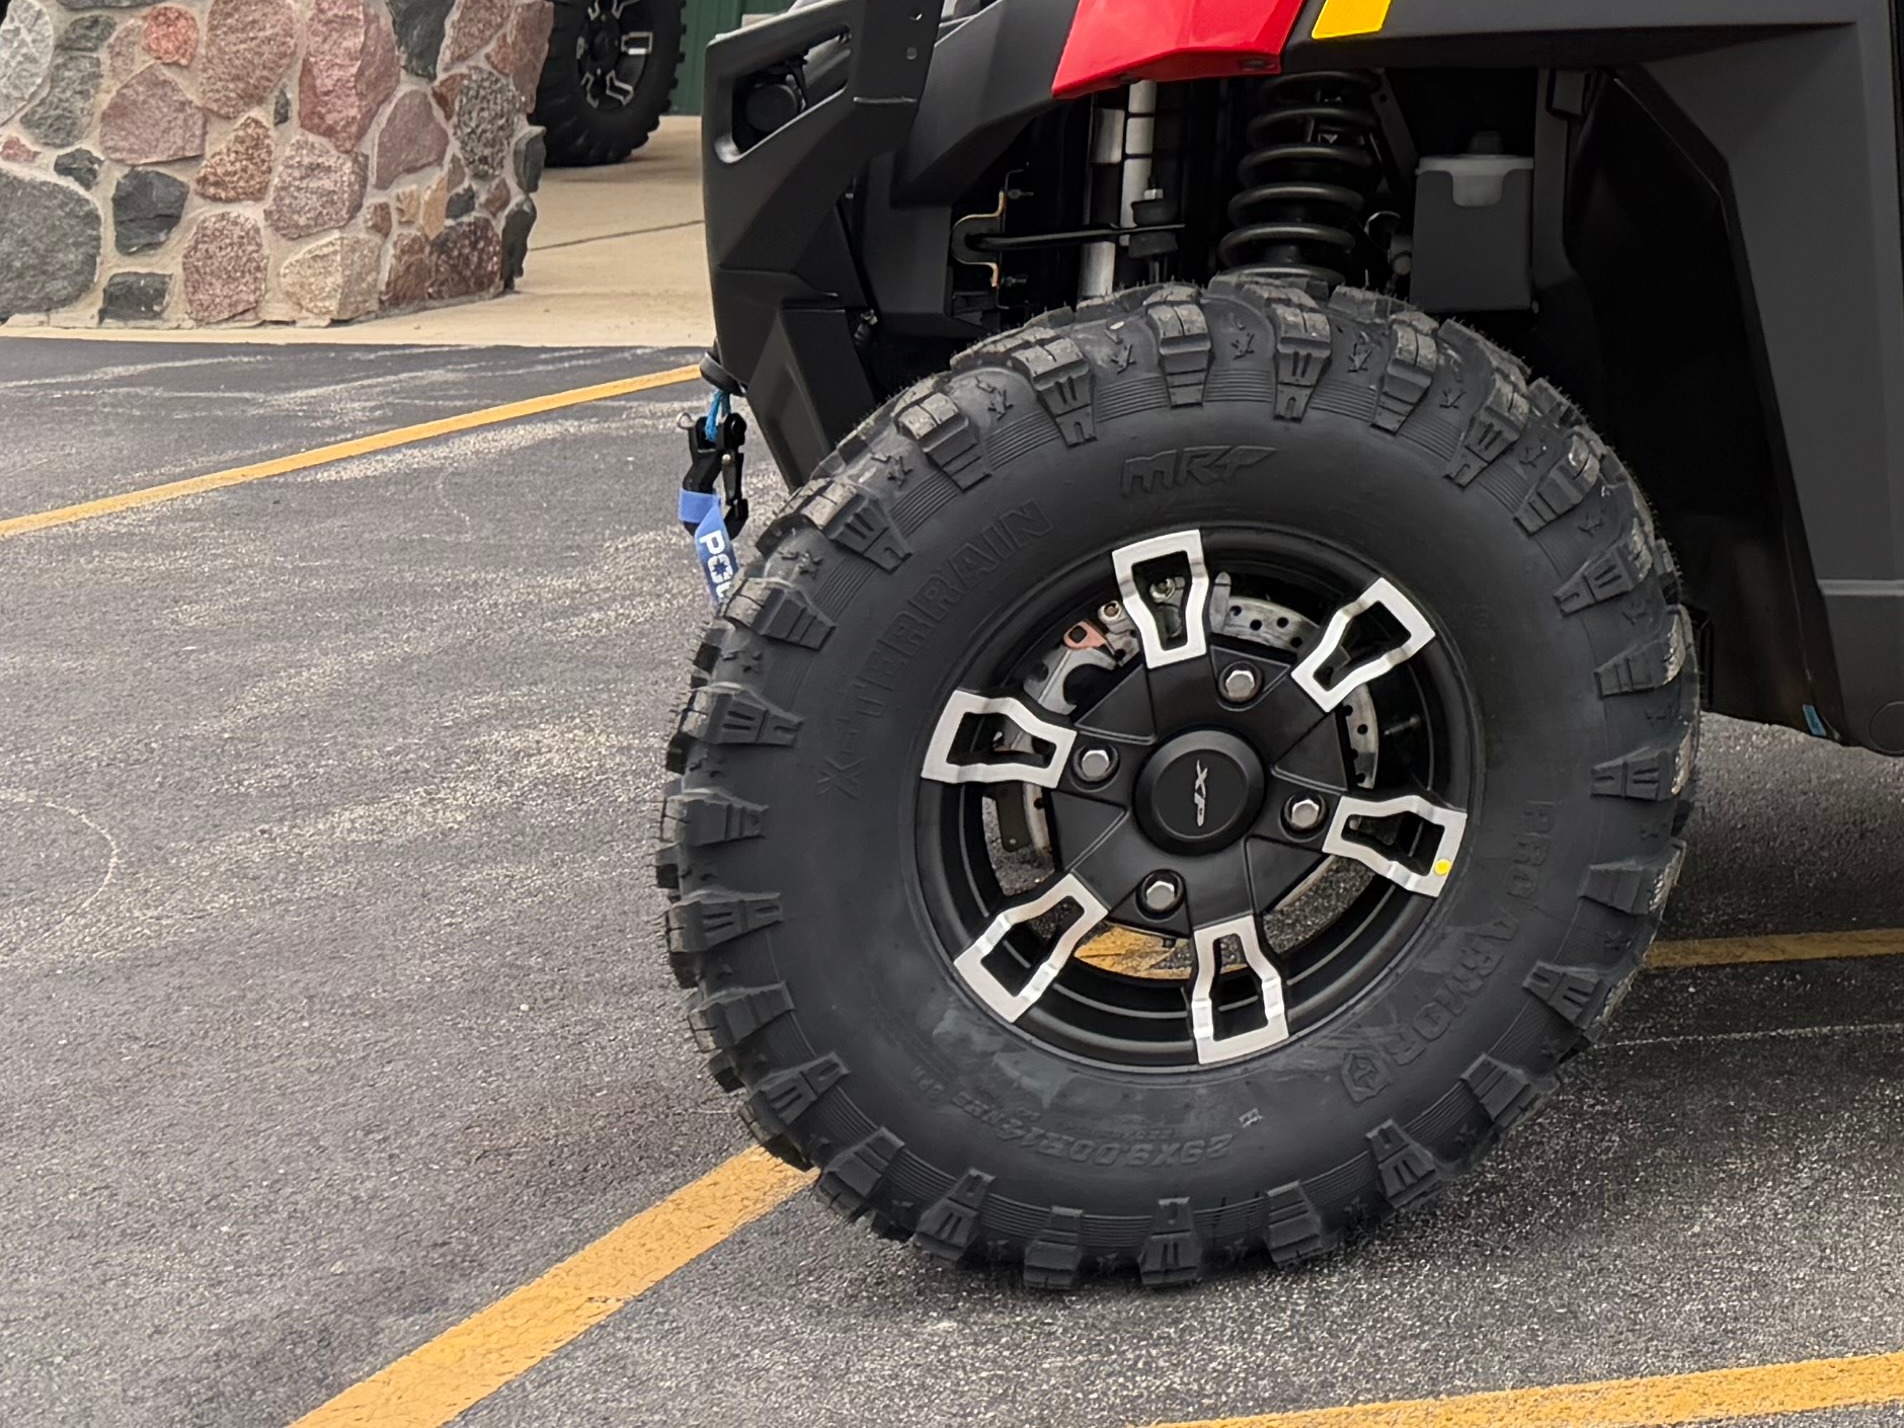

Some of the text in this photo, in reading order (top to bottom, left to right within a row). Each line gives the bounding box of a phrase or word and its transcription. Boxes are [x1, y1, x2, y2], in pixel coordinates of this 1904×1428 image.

[699, 529, 734, 600] POL
[816, 497, 1054, 801] X-TERRAIN
[1194, 759, 1209, 827] XP
